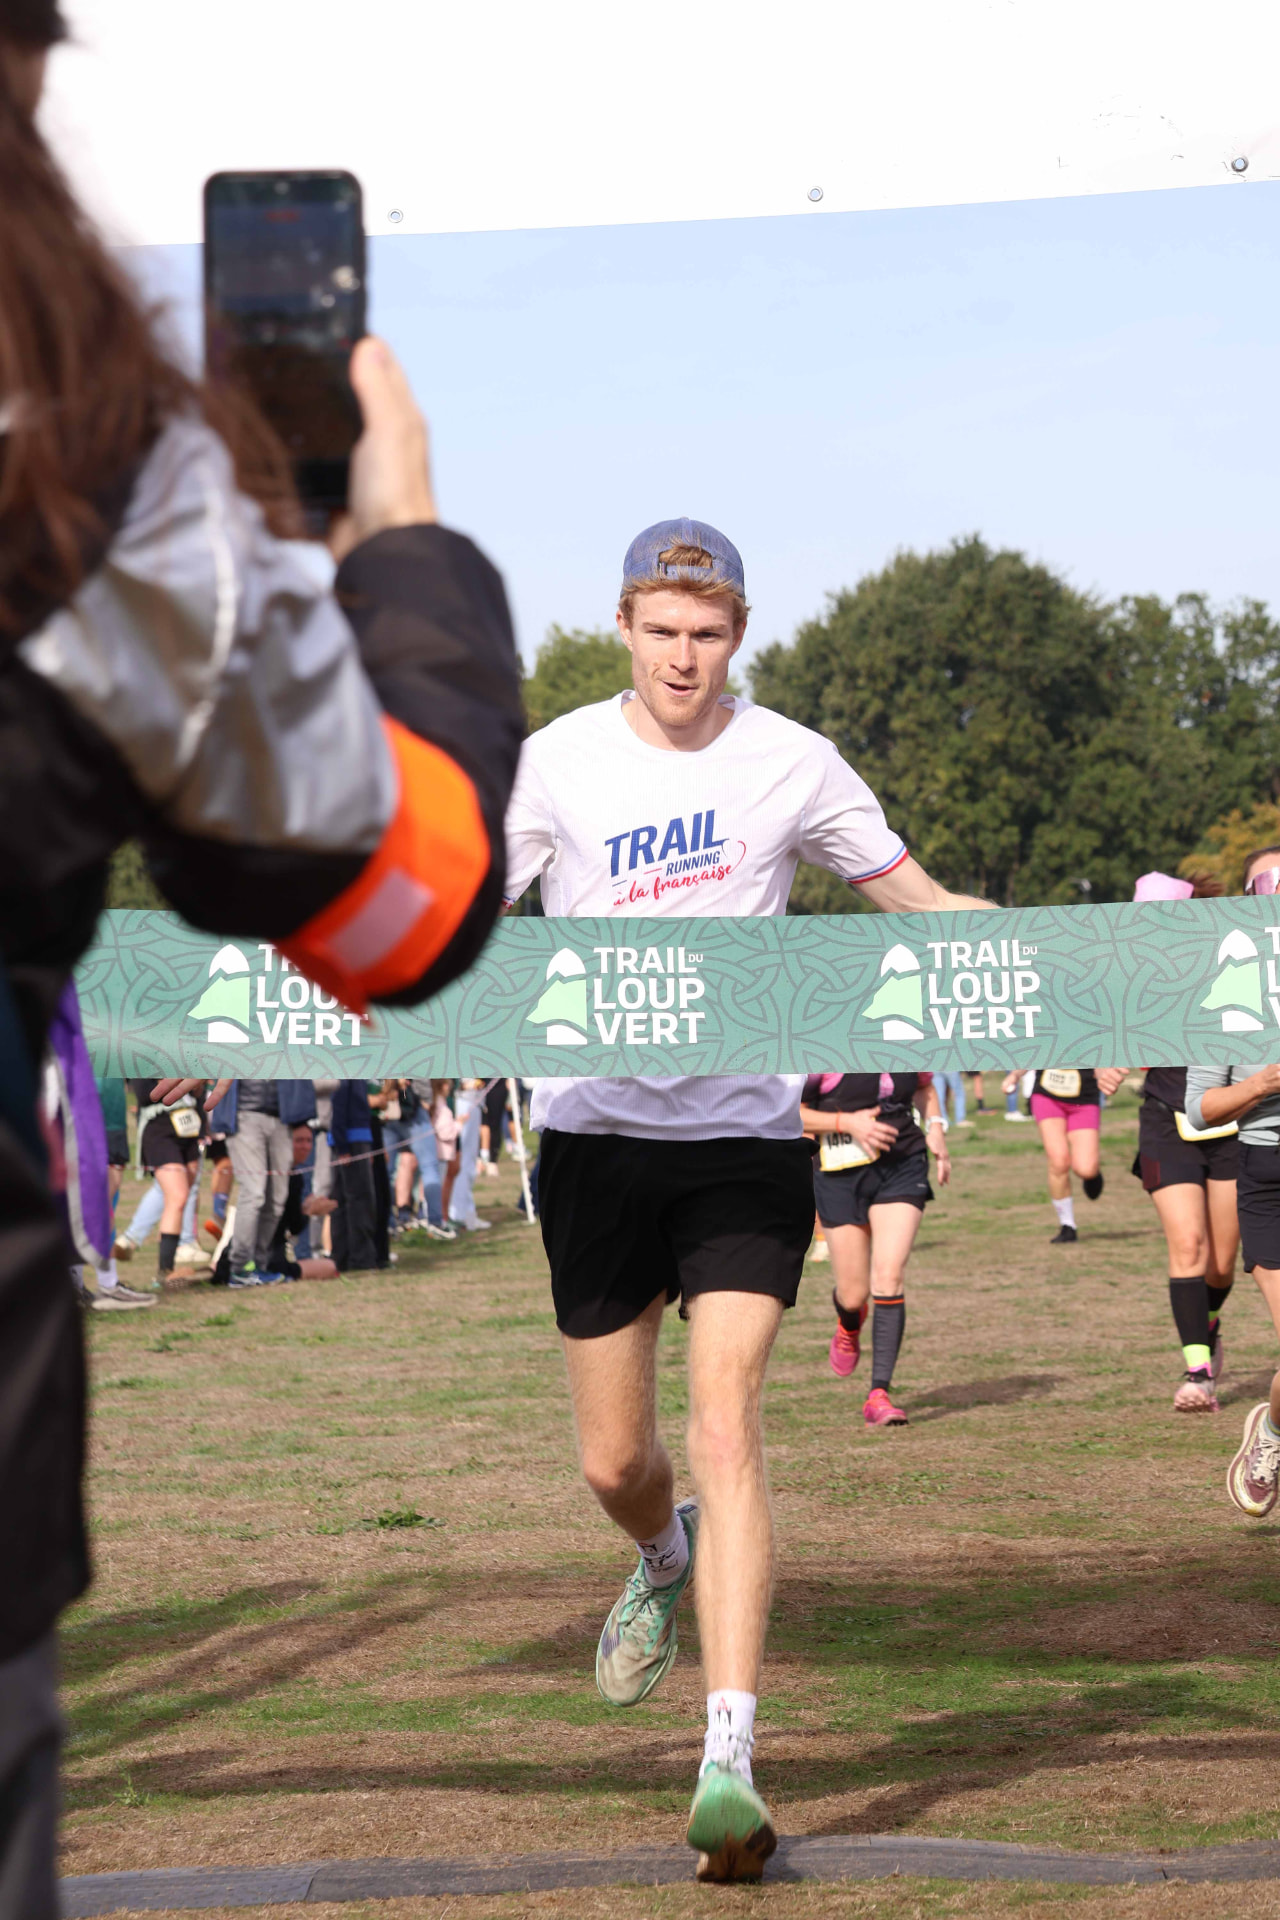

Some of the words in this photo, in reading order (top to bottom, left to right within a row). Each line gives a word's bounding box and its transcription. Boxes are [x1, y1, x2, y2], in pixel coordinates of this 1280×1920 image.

[604, 809, 729, 878] TRAIL
[666, 851, 720, 876] RUNNING
[629, 880, 649, 903] la
[593, 946, 697, 974] TRAIL
[688, 953, 704, 963] DU
[926, 939, 1032, 969] TRAIL
[1022, 946, 1038, 956] DU
[256, 975, 348, 1010] LOU
[593, 977, 706, 1010] LOUP
[927, 970, 1041, 1005] LOUP
[256, 1011, 369, 1046] VERT
[593, 1011, 706, 1045] VERT
[928, 1005, 1042, 1040] VERT
